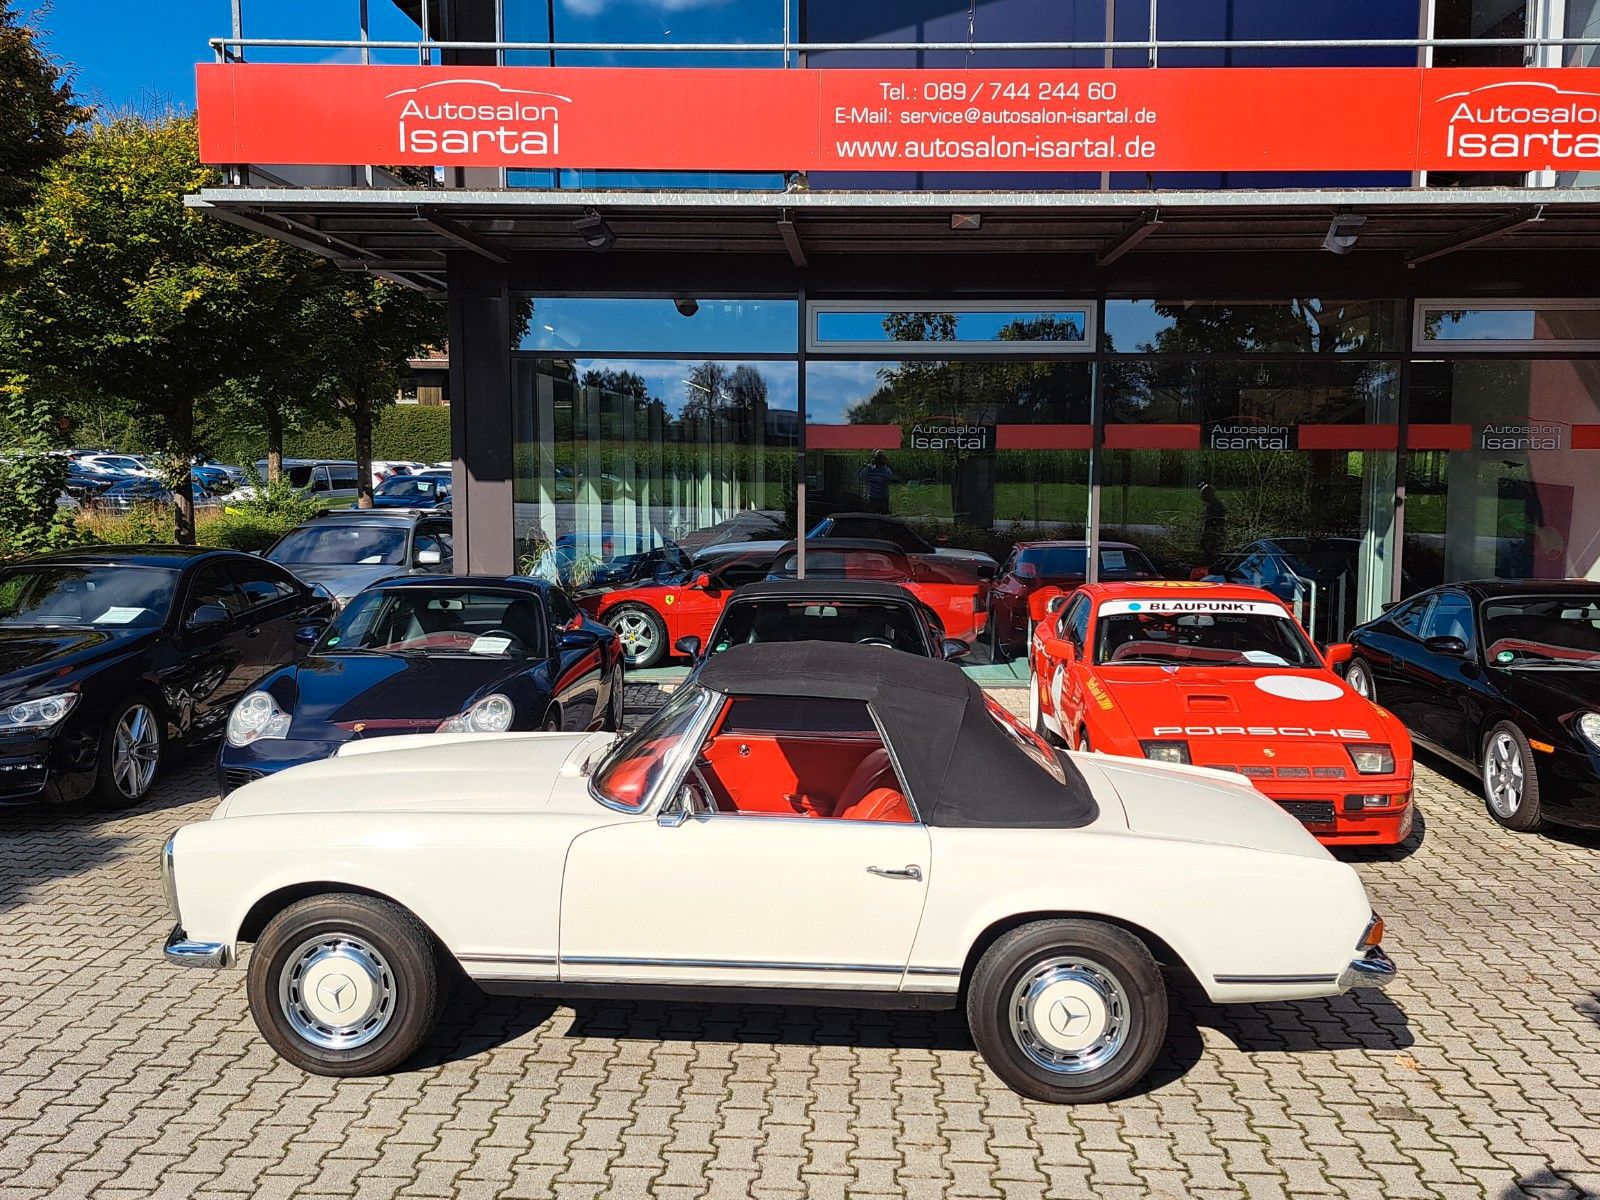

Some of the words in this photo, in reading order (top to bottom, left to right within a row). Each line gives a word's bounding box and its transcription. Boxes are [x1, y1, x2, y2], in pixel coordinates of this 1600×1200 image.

[880, 83, 917, 101] Tel.:
[924, 83, 967, 101] 089
[990, 83, 1031, 101] 744
[1038, 83, 1081, 101] 244
[1087, 83, 1117, 101] 60
[399, 100, 559, 123] Autosalon
[835, 107, 892, 125] E-Mail:
[901, 107, 1157, 127] service@autosalon-isartal.de
[1449, 102, 1600, 124] Autosalo
[399, 120, 559, 155] Isartal
[835, 135, 1156, 159] www.autosalon-isartal.de
[911, 424, 986, 434] Autosalon
[1211, 424, 1288, 434] Autosalon
[1483, 424, 1561, 434] Autosalon
[910, 434, 986, 449] Isartal
[1210, 434, 1288, 449] Isartal
[1482, 434, 1561, 449] Isartal
[1149, 603, 1256, 611] BLAUPUNKT
[1152, 726, 1371, 740] PORSCHE
